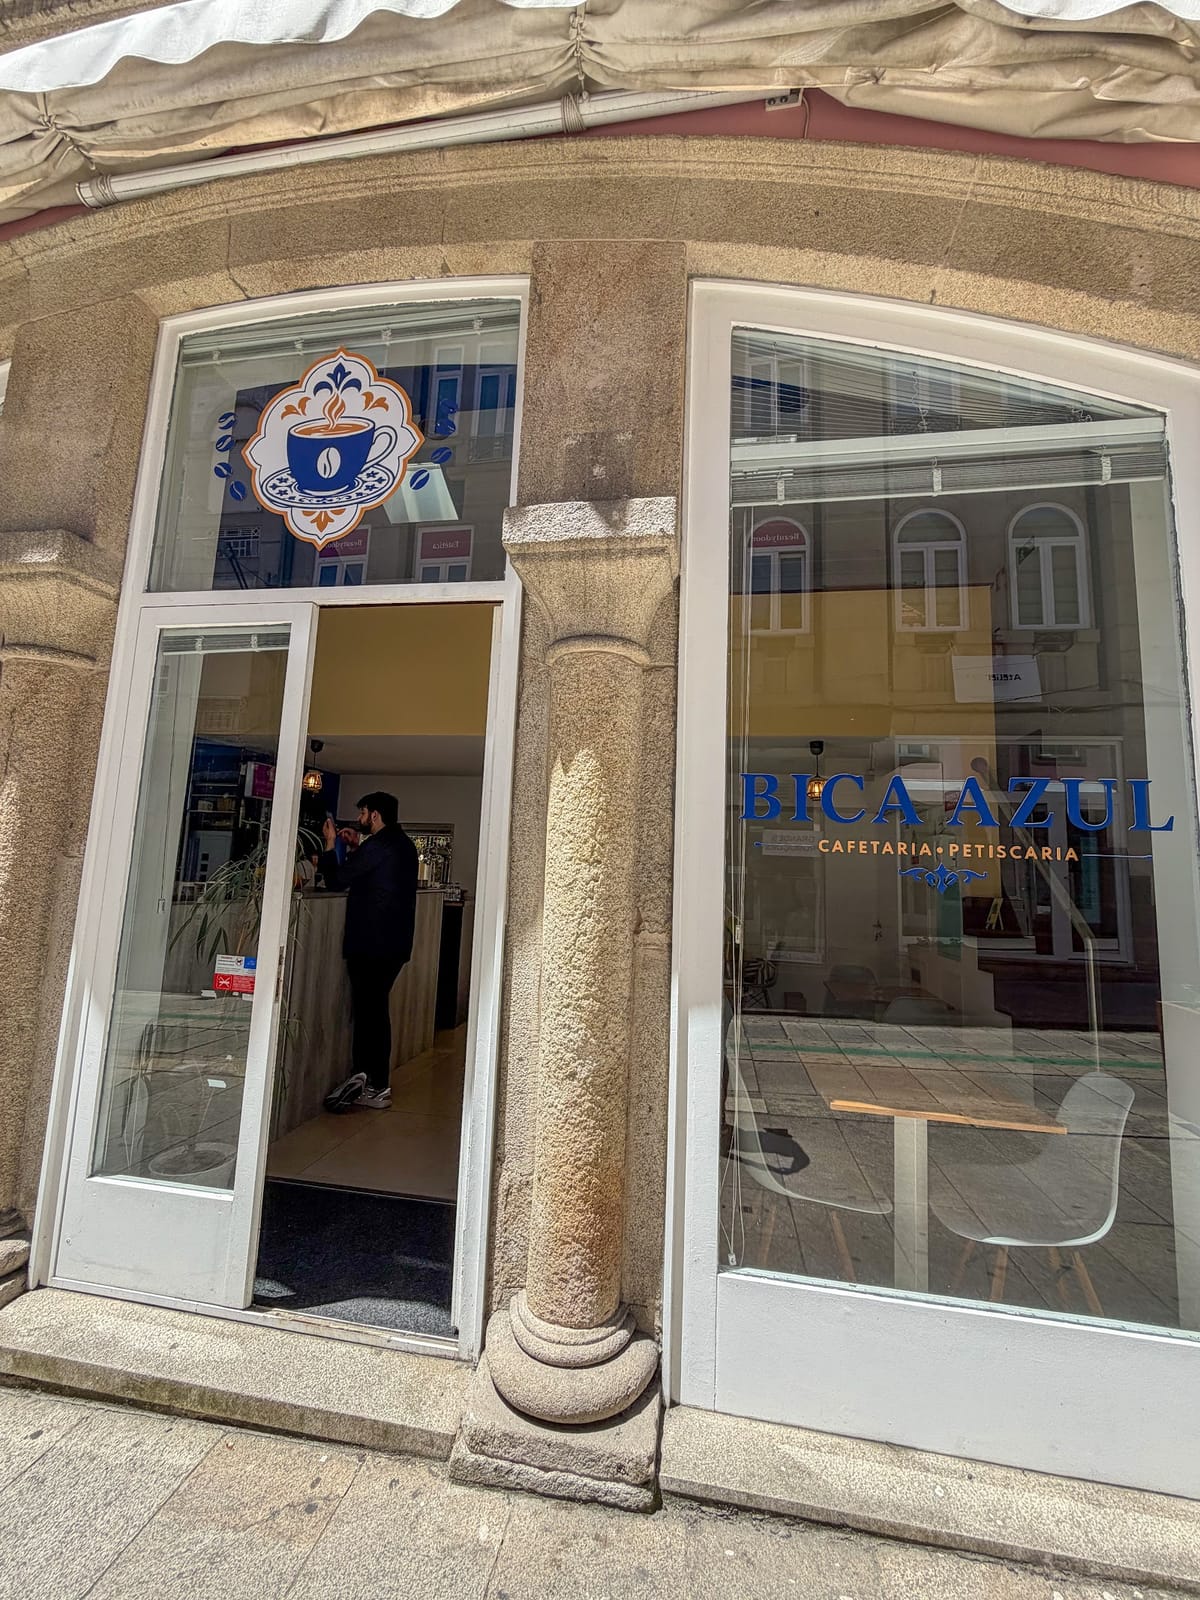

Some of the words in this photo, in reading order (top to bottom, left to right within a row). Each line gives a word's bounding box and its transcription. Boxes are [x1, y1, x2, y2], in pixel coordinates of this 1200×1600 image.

[739, 773, 925, 825] BICA
[947, 776, 1175, 832] AZUL
[817, 839, 932, 856] CAFETARIA
[948, 843, 1080, 862] PETISCARIA
